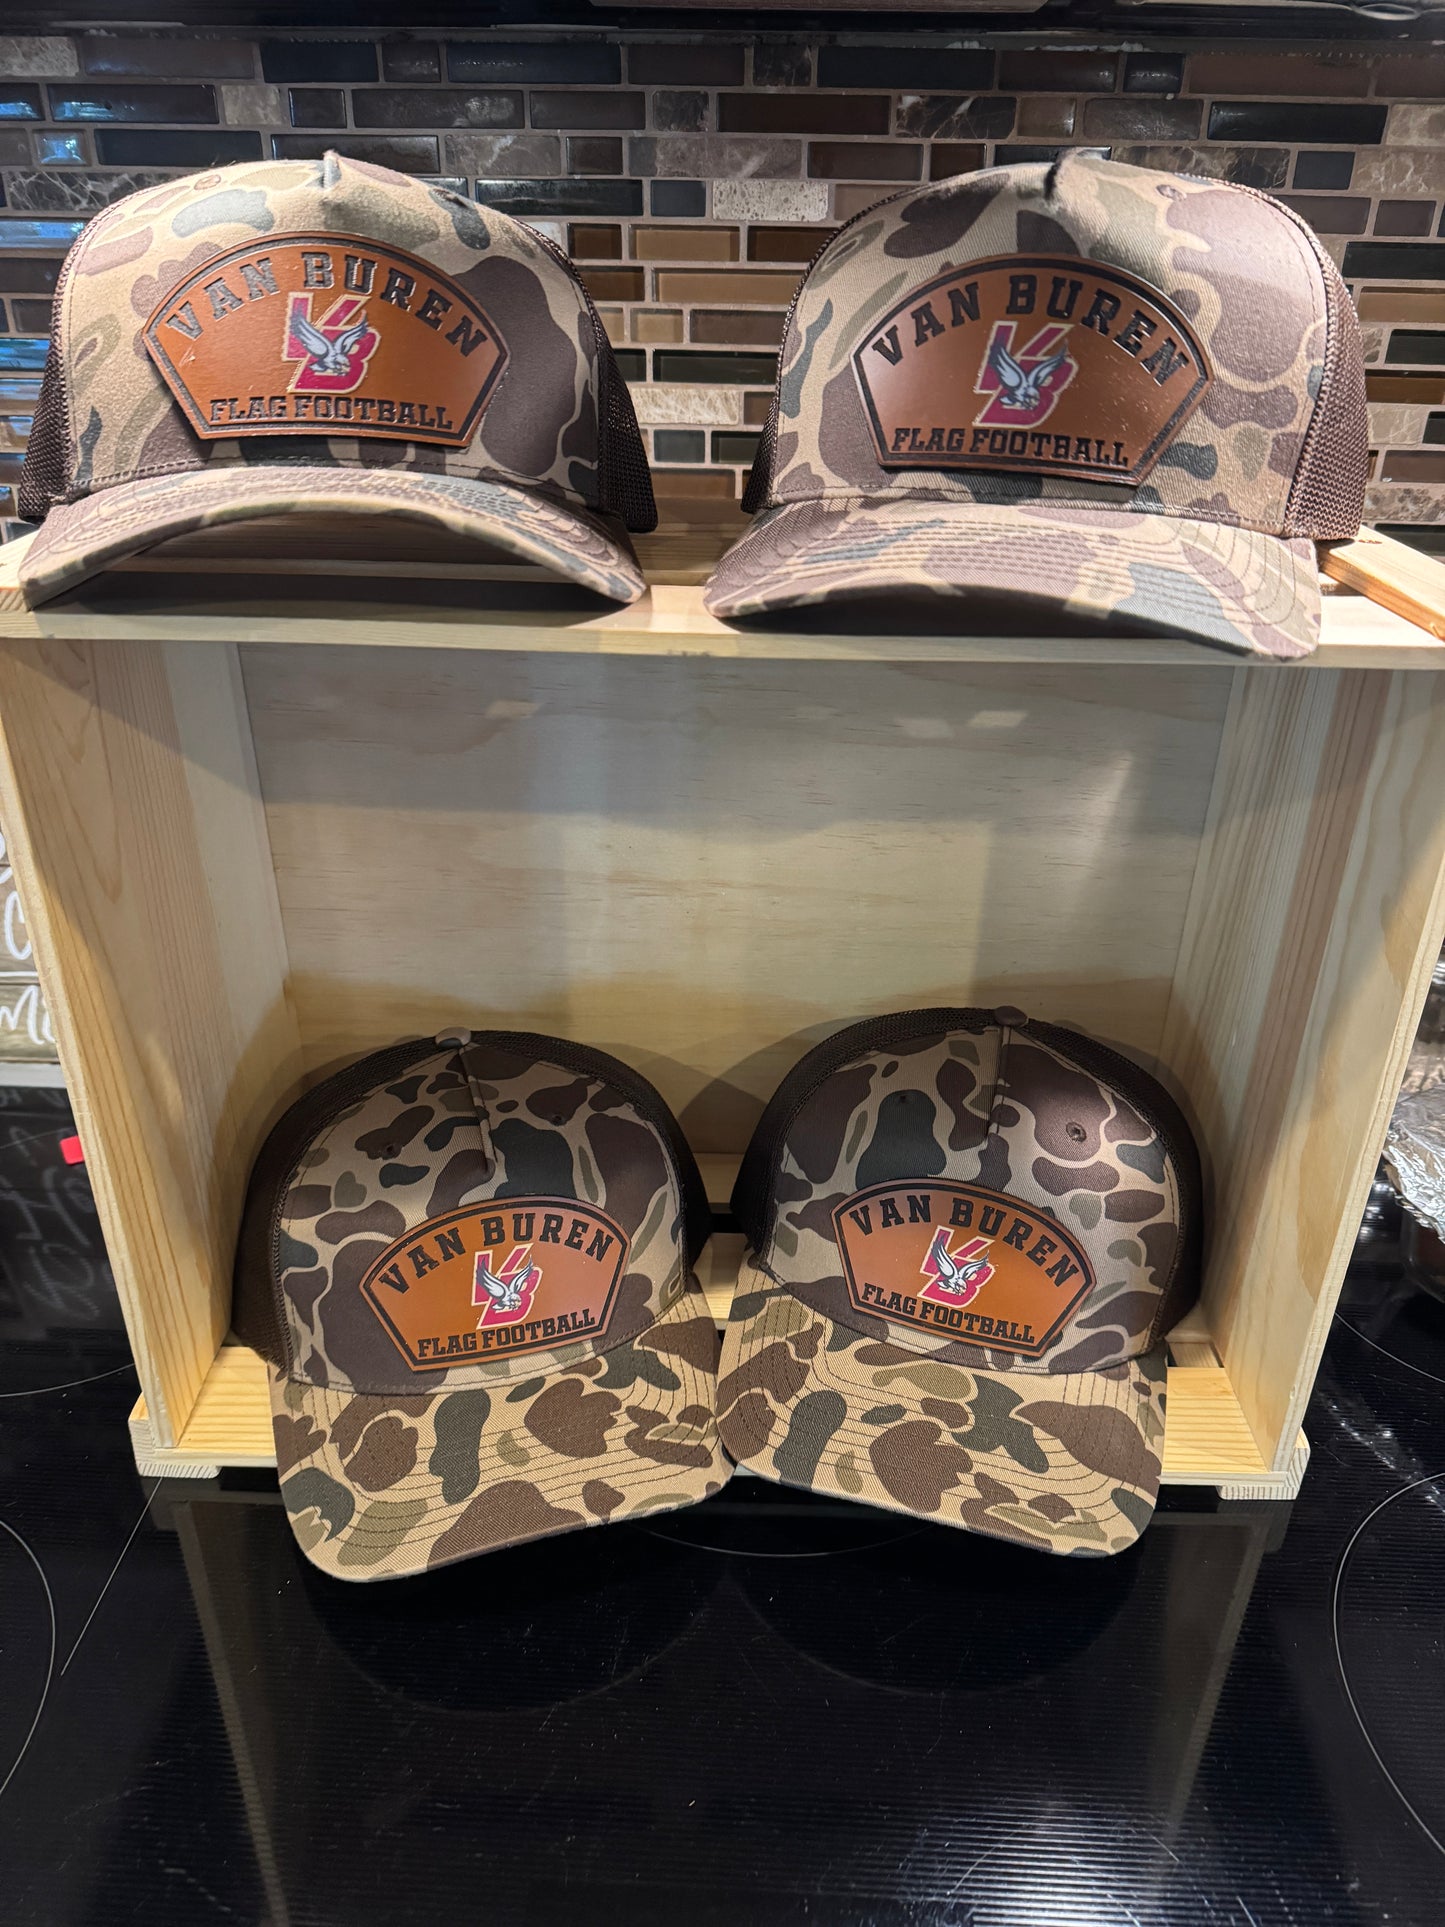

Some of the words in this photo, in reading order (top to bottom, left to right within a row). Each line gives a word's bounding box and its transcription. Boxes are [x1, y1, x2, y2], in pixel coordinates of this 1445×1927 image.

[167, 257, 280, 341] VAN
[301, 252, 487, 358] BUREN
[872, 281, 981, 366] VAN
[1006, 274, 1190, 387] BUREN
[209, 396, 288, 422] FLAG
[294, 395, 453, 430] FOOTBALL
[891, 427, 965, 452] FLAG
[969, 428, 1129, 467] FOOTBALL
[378, 1227, 467, 1294] VAN
[480, 1213, 615, 1262] BUREN
[850, 1195, 931, 1236] VAN
[949, 1197, 1080, 1287] BUREN
[417, 1332, 477, 1358] FLAG
[482, 1308, 595, 1349] FOOTBALL
[861, 1283, 918, 1313] FLAG
[919, 1302, 1035, 1344] FOOTBALL
